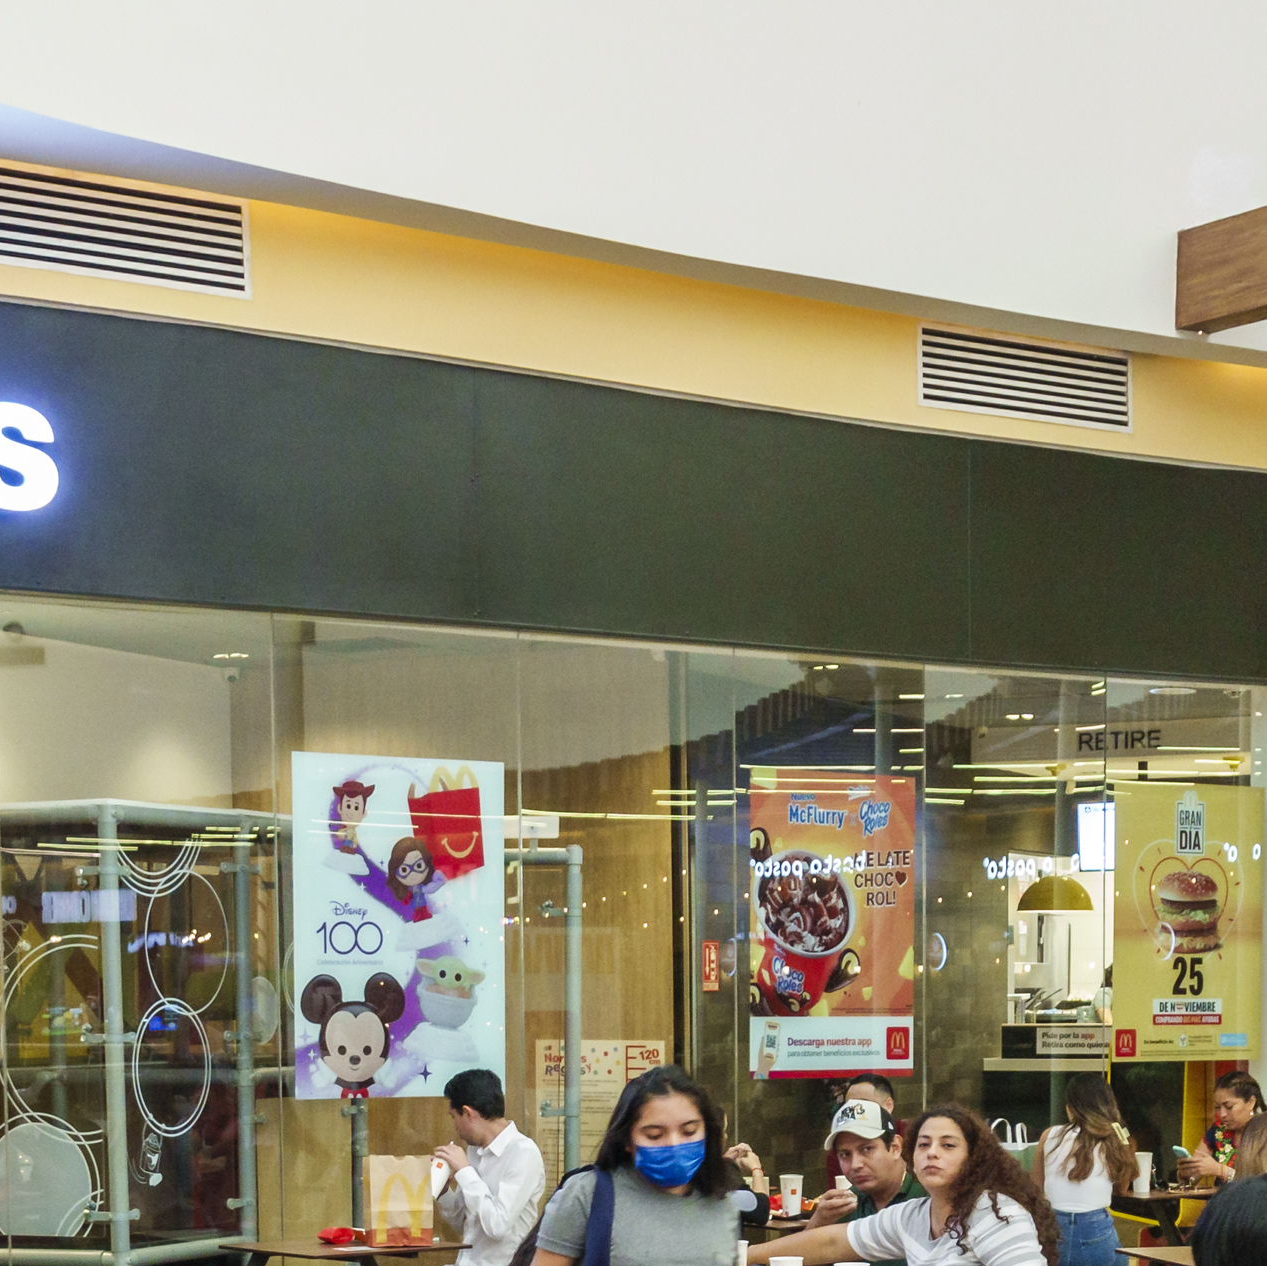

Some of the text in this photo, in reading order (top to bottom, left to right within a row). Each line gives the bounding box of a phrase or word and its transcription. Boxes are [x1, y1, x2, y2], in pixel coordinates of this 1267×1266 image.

[1078, 729, 1162, 751] RETIRE
[788, 803, 846, 829] McFlurry
[859, 798, 891, 821] Choco
[1179, 809, 1202, 827] GRAN
[862, 813, 889, 838] Roles
[1179, 826, 1201, 850] DÍA
[877, 850, 911, 867] LATE
[853, 871, 894, 888] CHOC
[866, 891, 896, 907] ROL!
[330, 900, 368, 920] Disney
[316, 921, 384, 955] 100
[1172, 956, 1204, 996] 25
[1159, 1001, 1216, 1013] DE NVIEMBRE
[787, 1037, 872, 1048] Descarga nuestra app
[1059, 1032, 1071, 1041] por
[544, 1053, 587, 1063] Nors
[639, 1049, 660, 1061] 120
[545, 1063, 586, 1077] Regs
